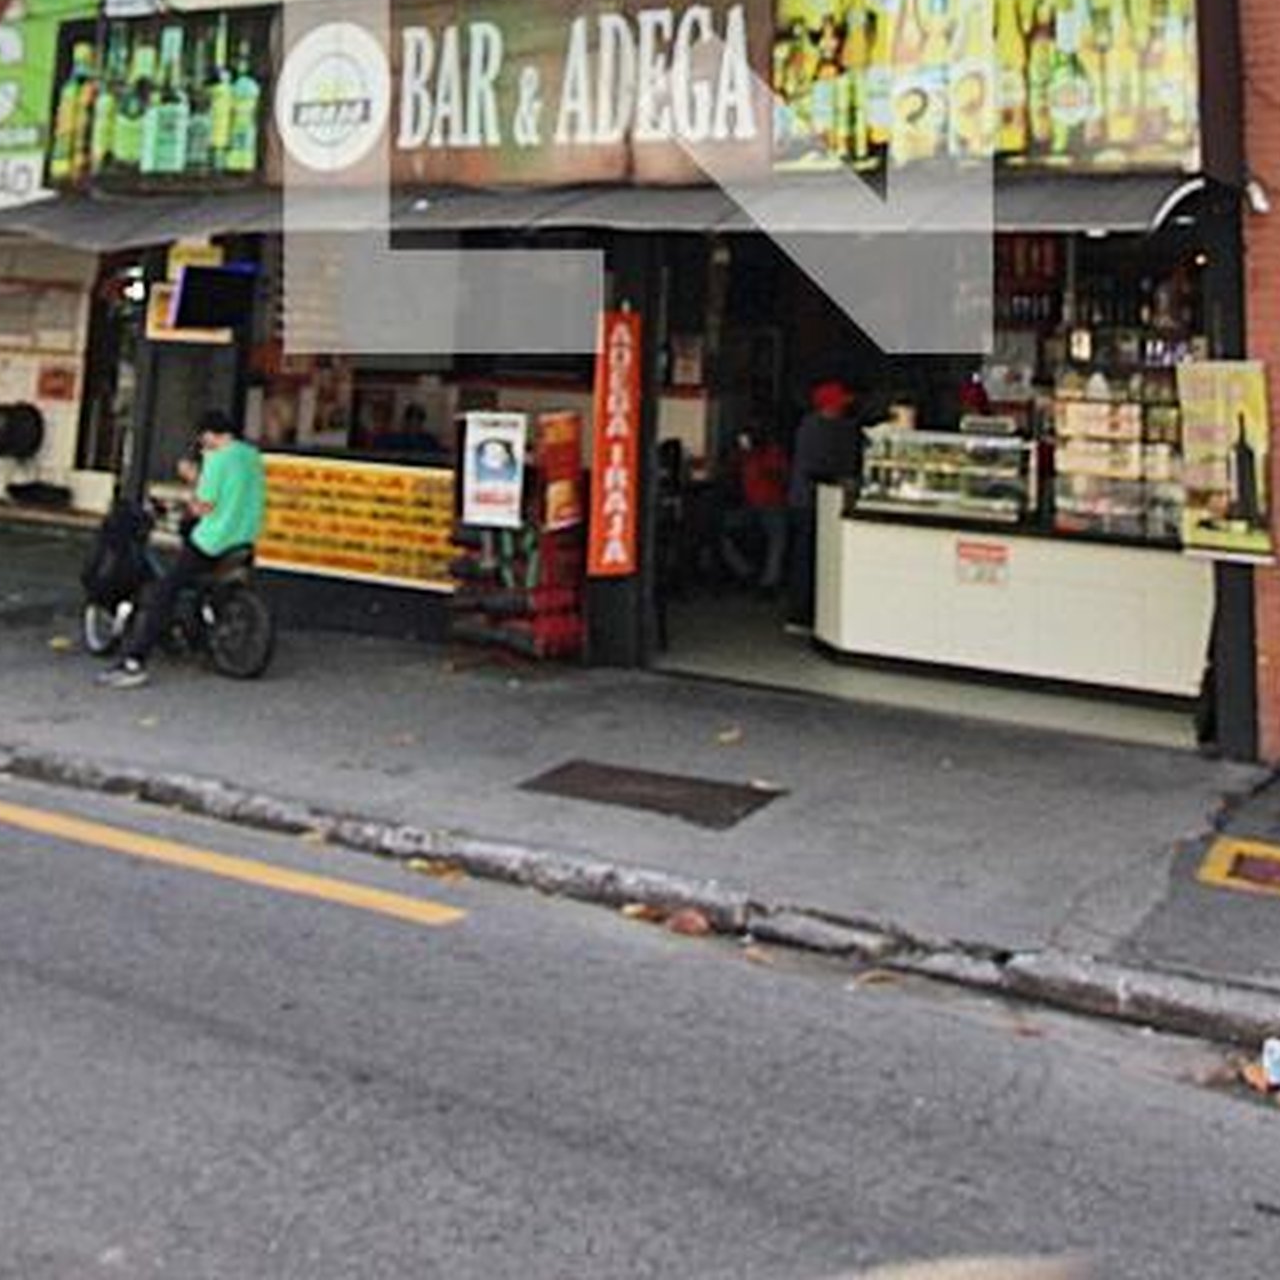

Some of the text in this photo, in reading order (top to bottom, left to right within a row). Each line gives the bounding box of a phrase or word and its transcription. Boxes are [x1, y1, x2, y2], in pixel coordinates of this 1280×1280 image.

[397, 5, 758, 149] BAR & ADEGA
